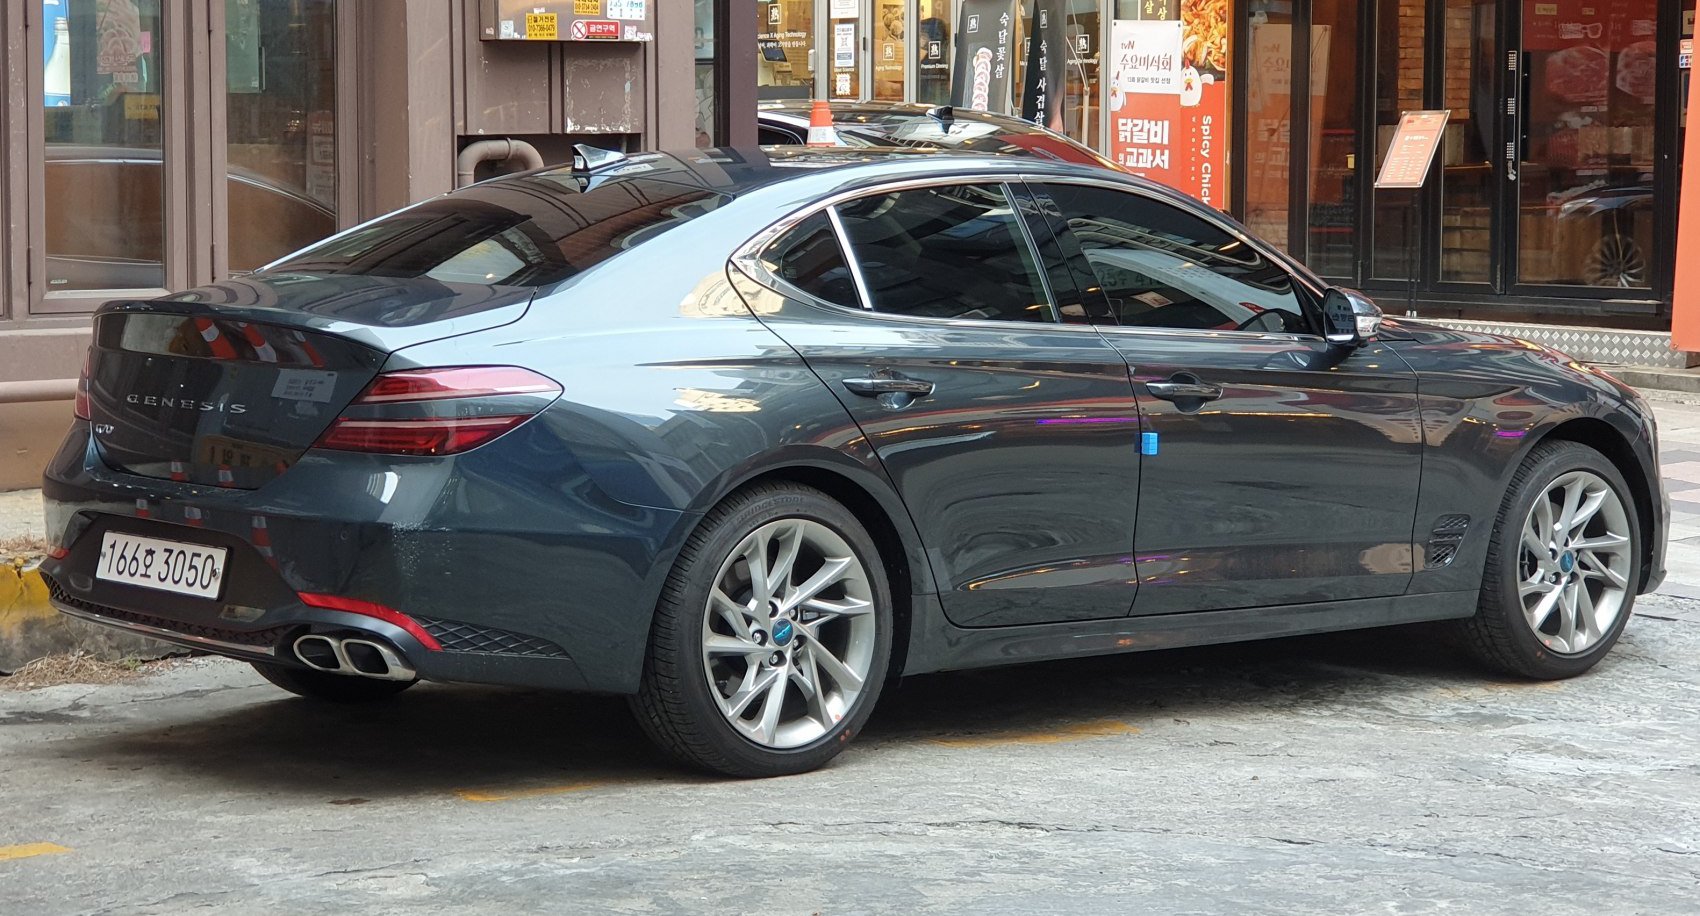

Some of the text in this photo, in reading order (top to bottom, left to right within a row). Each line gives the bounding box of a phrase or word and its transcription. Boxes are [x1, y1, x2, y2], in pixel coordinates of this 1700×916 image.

[589, 24, 616, 33] 금연구역
[1121, 41, 1135, 50] tvN
[1120, 53, 1172, 72] 수요미식회
[1118, 118, 1170, 145] 닭갈비
[1200, 115, 1213, 158] Spicy
[1126, 147, 1170, 170] 교과서
[126, 393, 247, 415] GENESIS
